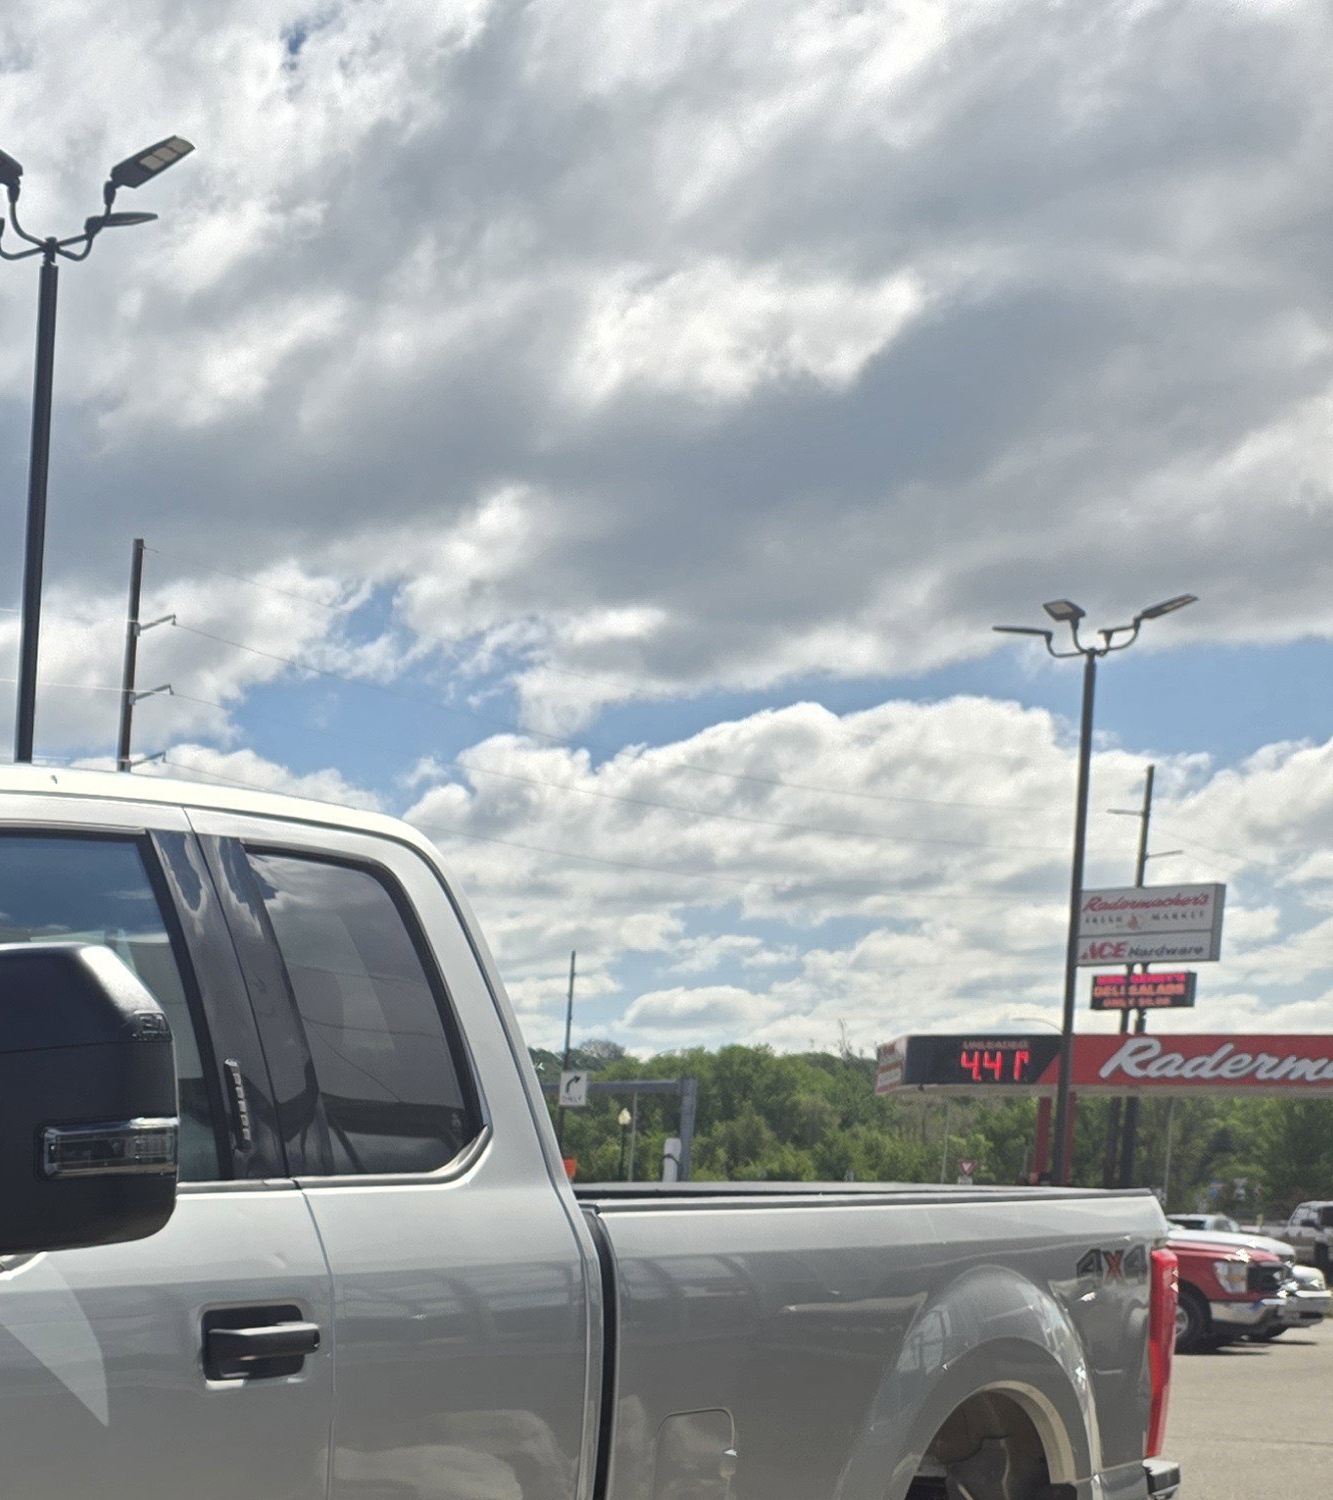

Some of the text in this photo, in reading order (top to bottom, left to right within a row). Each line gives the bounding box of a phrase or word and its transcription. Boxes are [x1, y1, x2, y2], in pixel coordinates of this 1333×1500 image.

[1081, 941, 1204, 960] ACE Hardware
[1099, 1036, 1333, 1082] Raderm
